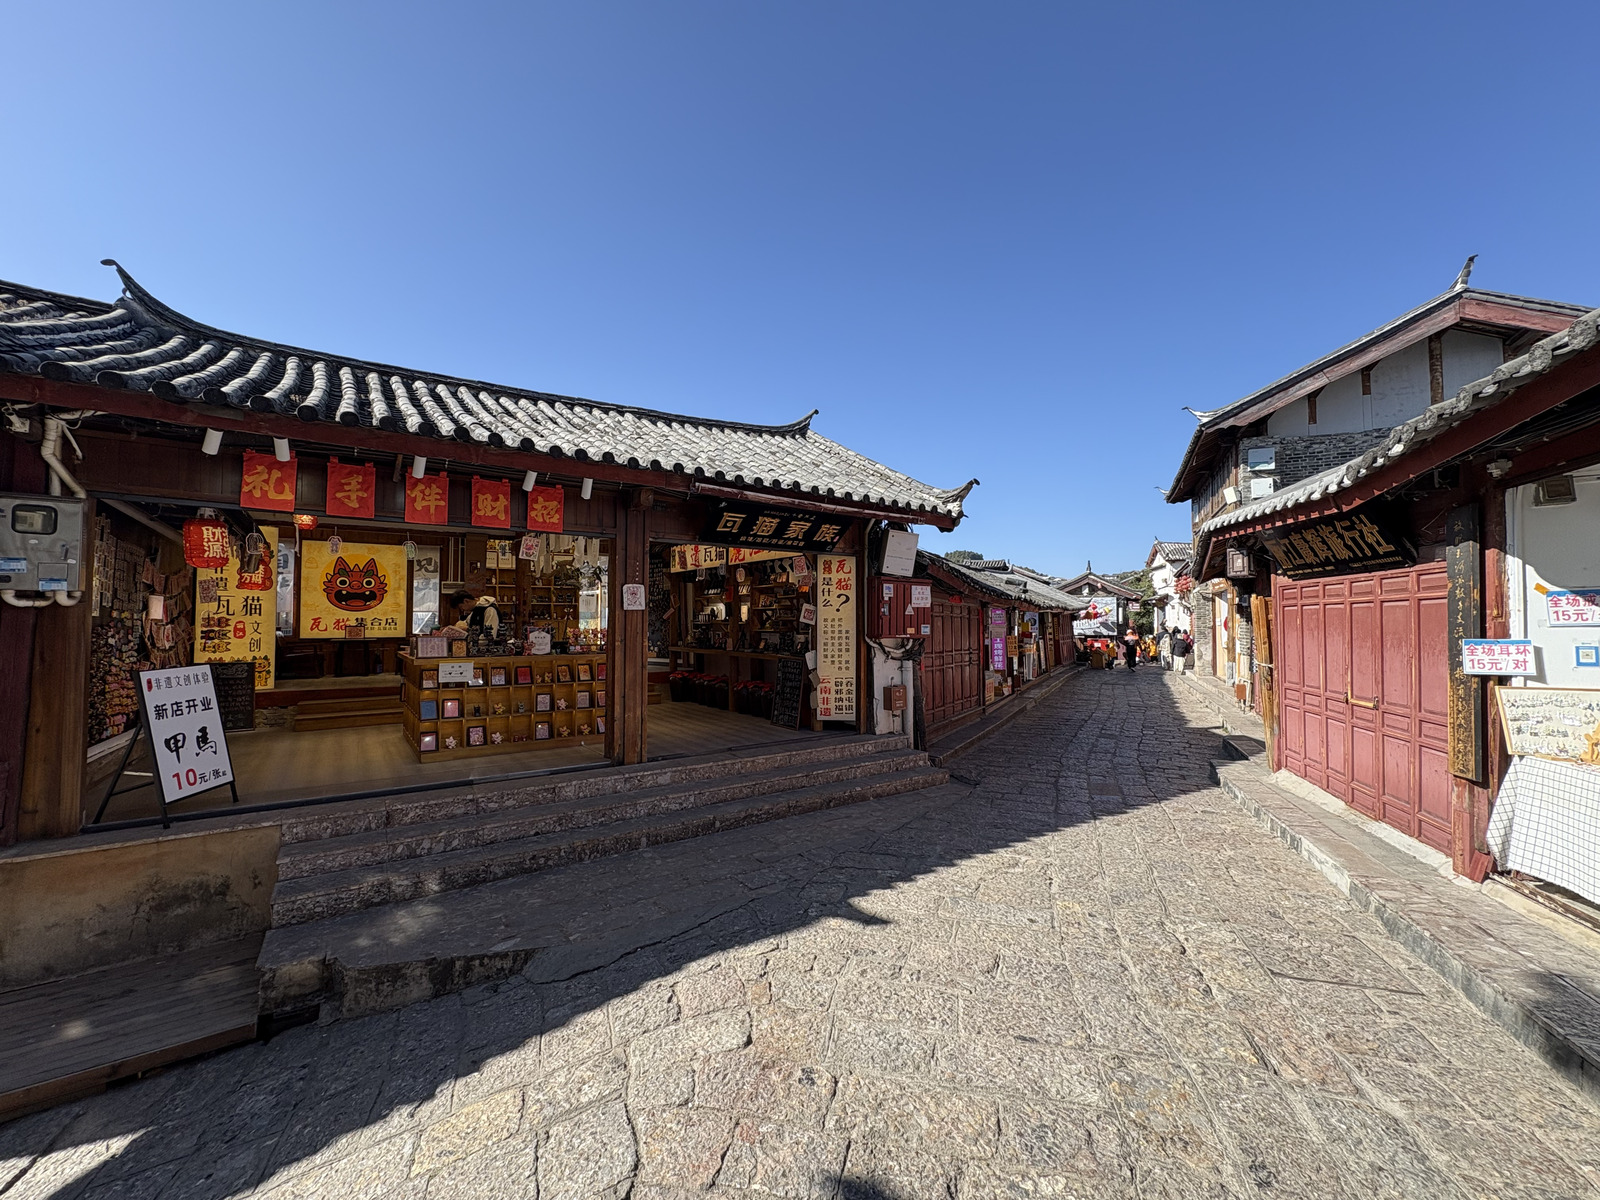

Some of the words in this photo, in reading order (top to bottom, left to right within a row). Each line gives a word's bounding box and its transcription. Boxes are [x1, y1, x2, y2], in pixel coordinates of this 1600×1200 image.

[242, 465, 295, 500] 礼
[335, 474, 368, 508] 手
[408, 482, 446, 518] 伴
[529, 496, 561, 525] 招
[716, 512, 841, 543] 瓦猫家族
[215, 595, 264, 617] 瓦猫
[821, 577, 834, 607] 是什么
[1552, 608, 1600, 622] 15元/
[248, 619, 262, 652] 文创
[1465, 644, 1531, 658] 全场耳环
[1468, 657, 1529, 672] 15元/对
[154, 672, 210, 690] 非遗文创体验
[153, 695, 214, 721] 新店开业
[819, 675, 832, 717] 云南非遗
